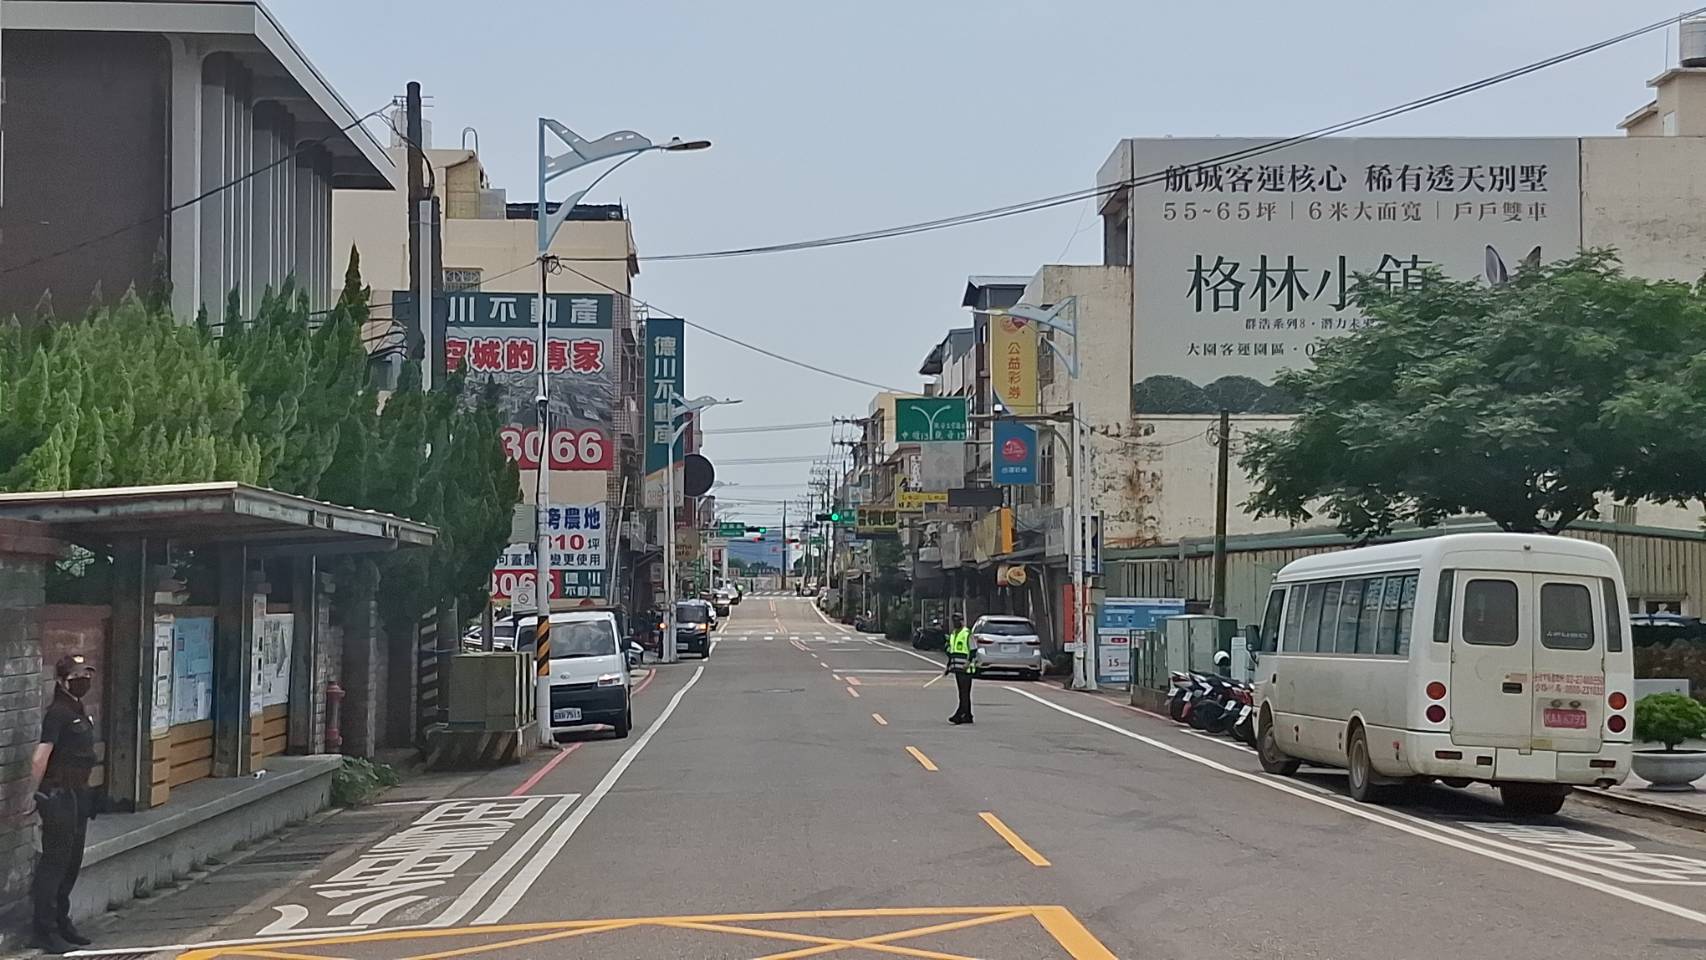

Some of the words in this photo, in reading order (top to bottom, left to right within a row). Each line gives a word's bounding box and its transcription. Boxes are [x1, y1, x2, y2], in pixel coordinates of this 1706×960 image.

[1164, 164, 1347, 193] 航城客運核心
[1364, 163, 1548, 193] 稀有透天別墅
[1309, 201, 1422, 222] 6米大面寬
[1453, 202, 1547, 222] 戶戶雙車
[498, 553, 601, 567] 可蓋農變更使用
